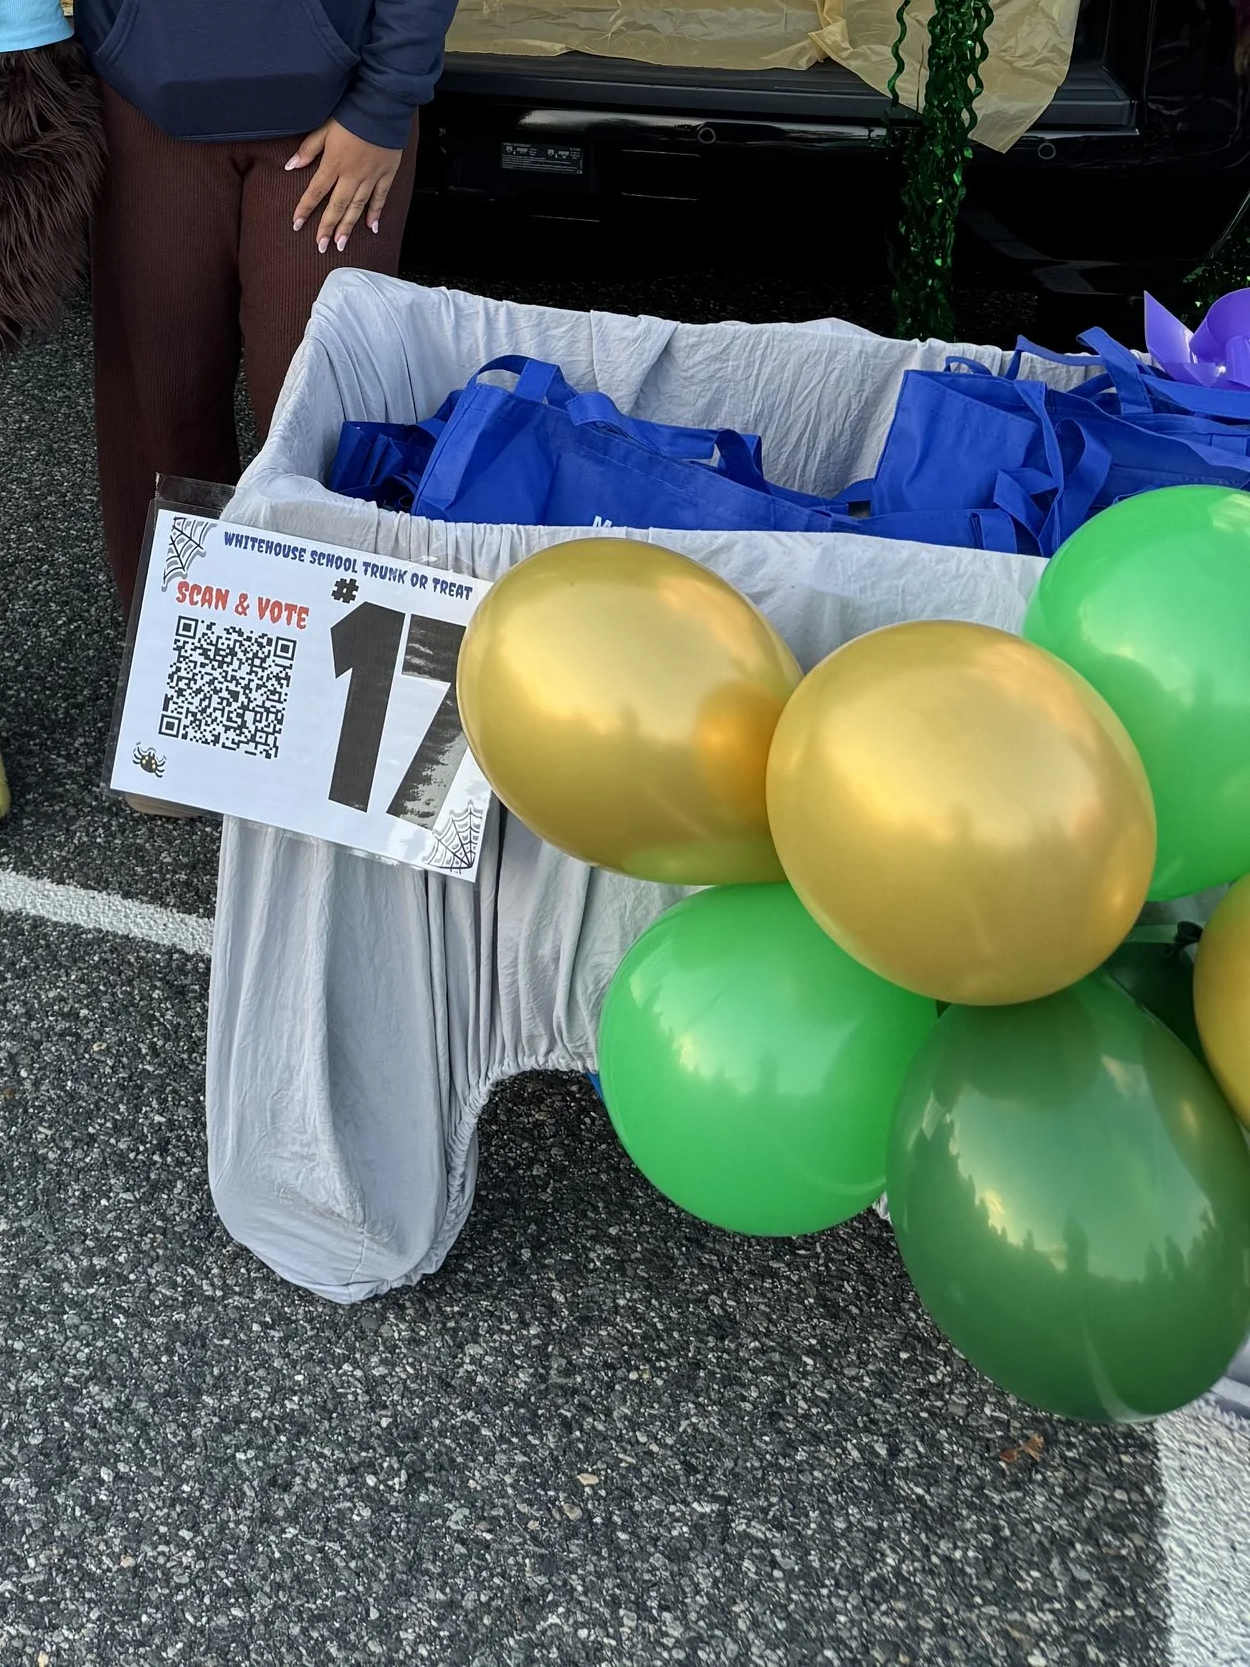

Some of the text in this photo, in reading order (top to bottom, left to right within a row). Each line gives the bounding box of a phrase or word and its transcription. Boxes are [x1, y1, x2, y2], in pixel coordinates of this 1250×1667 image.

[224, 531, 473, 601] WHITEHOUSE SCHOOL TRUNK OR TREAT
[175, 580, 310, 630] SCAN & VOTE
[328, 599, 467, 832] 17
